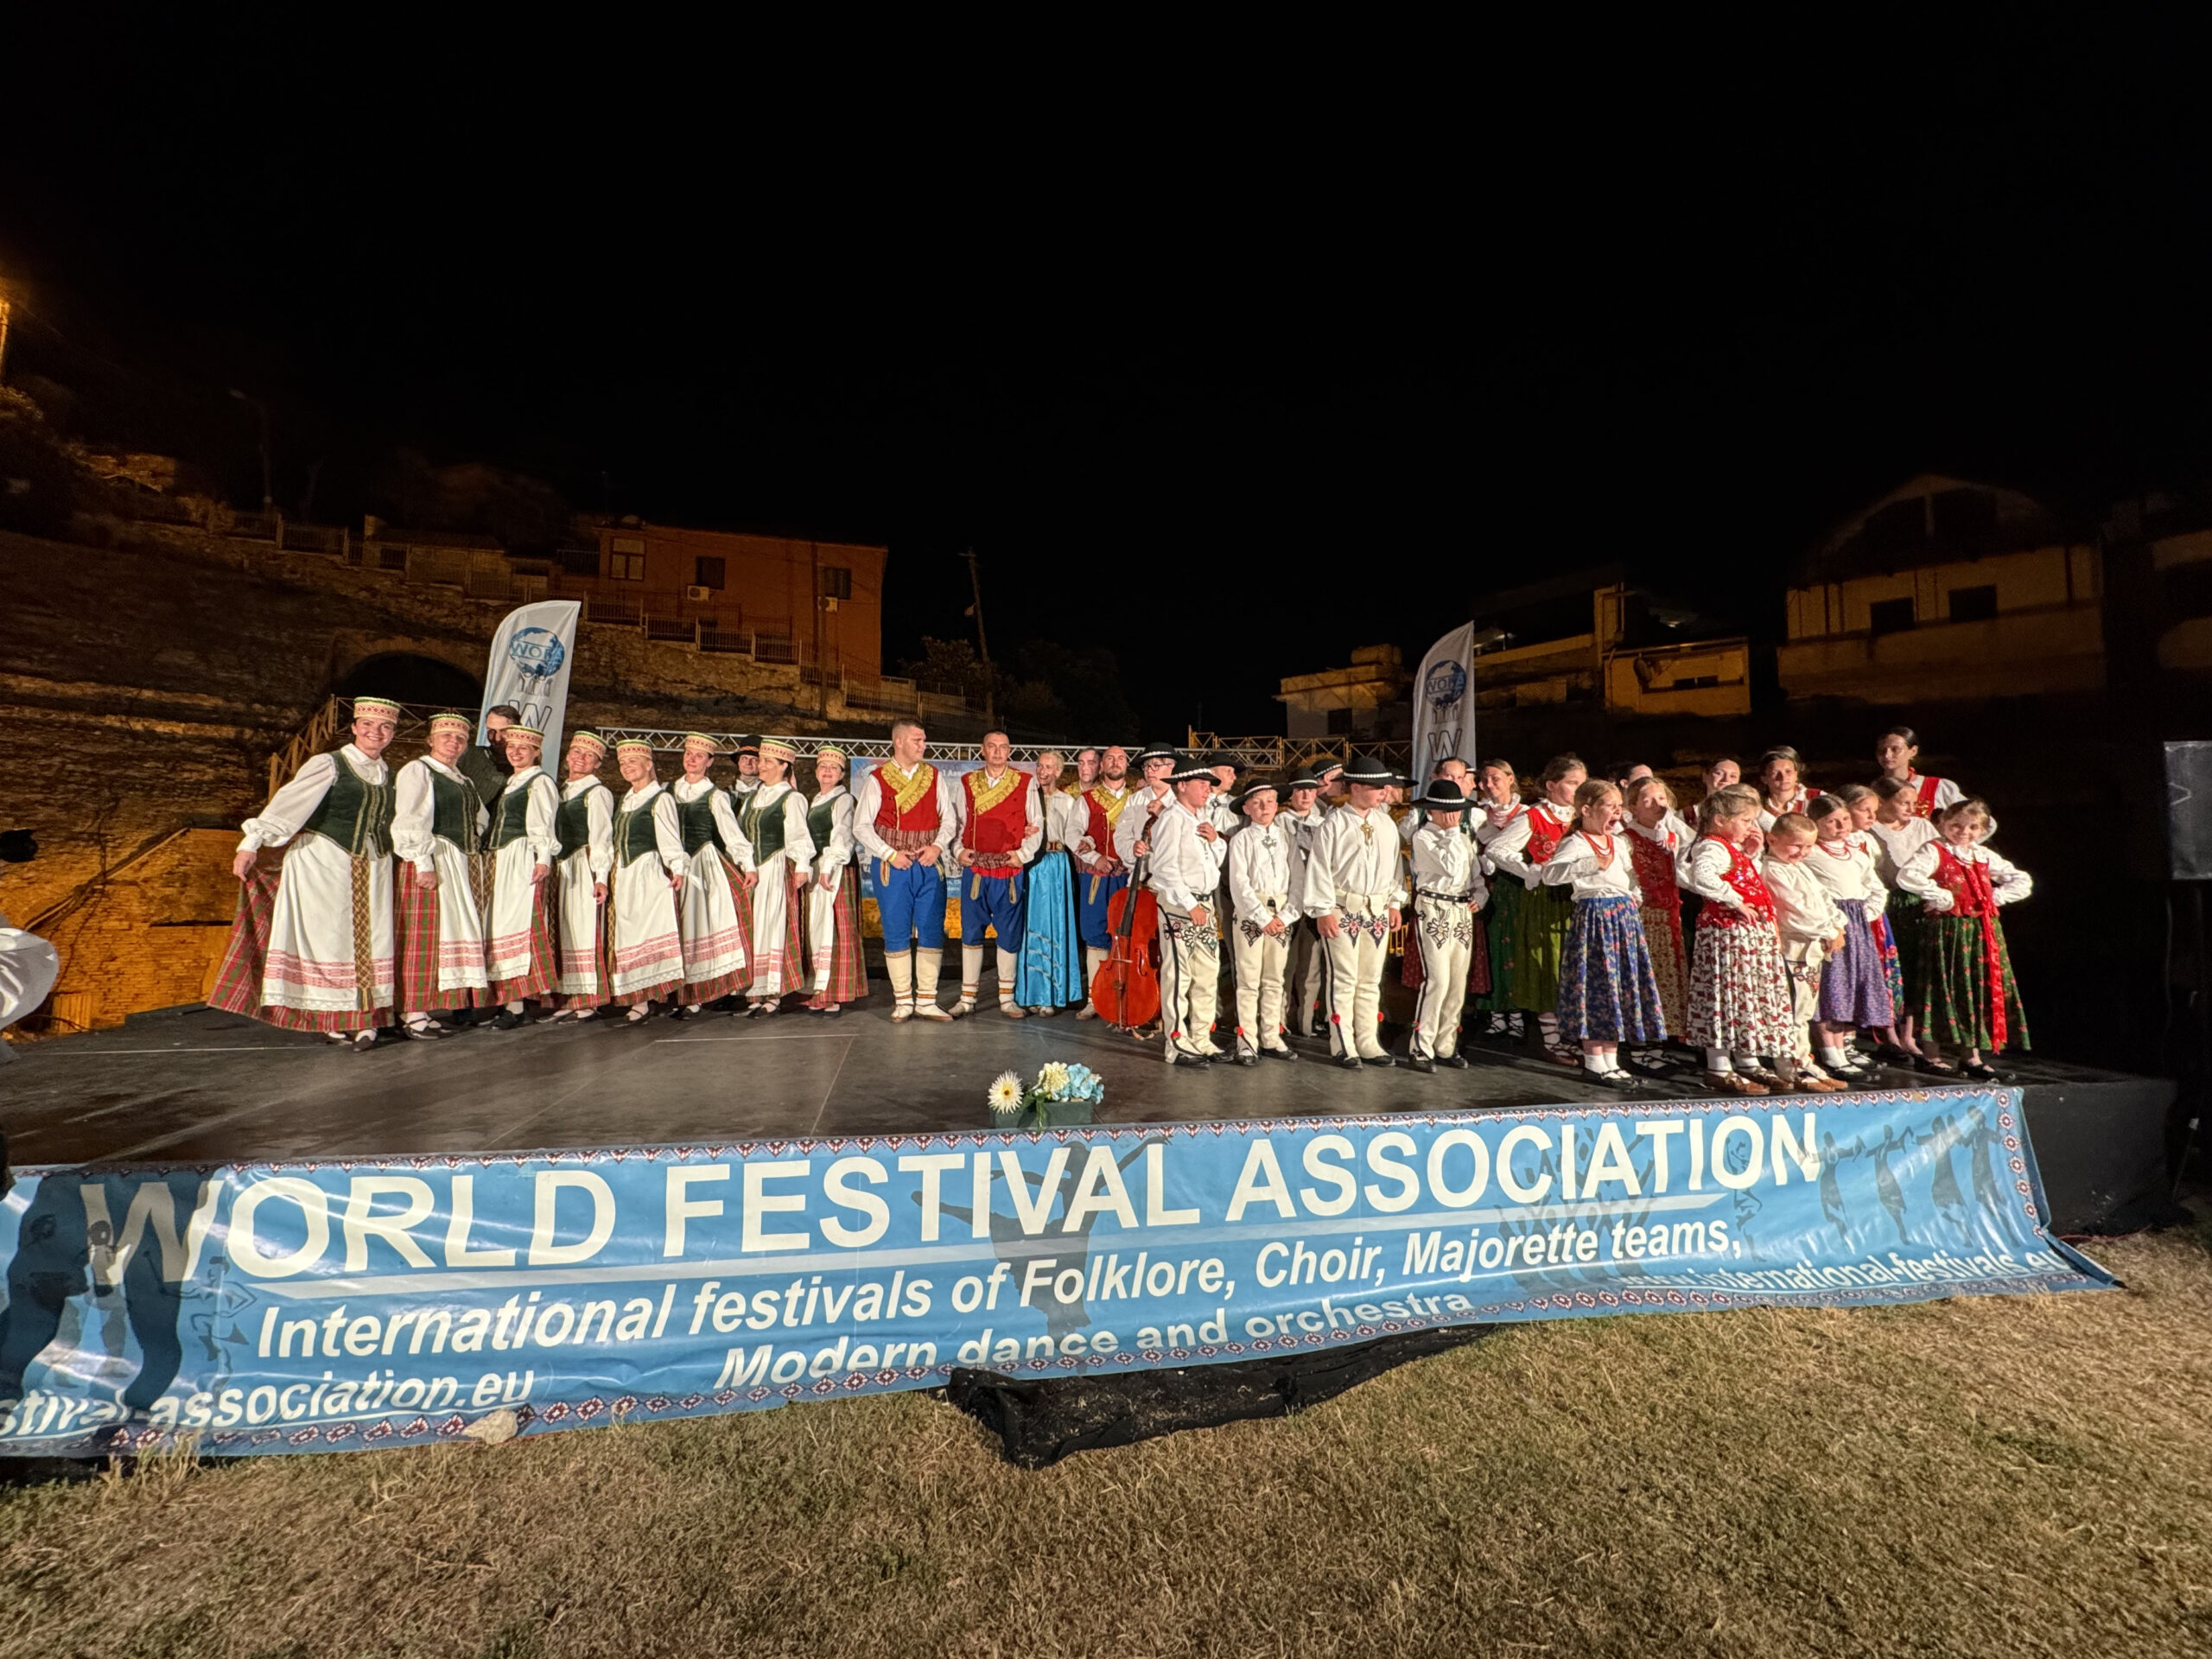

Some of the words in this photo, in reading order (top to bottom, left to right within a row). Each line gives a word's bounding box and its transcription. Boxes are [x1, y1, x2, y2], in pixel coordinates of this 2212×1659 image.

[79, 1170, 616, 1282] WORLD
[662, 1142, 1201, 1257] FESTIVAL
[1224, 1113, 1821, 1223] ASSOCIATION
[258, 1284, 677, 1358] International
[690, 1270, 933, 1335] festivals
[952, 1262, 1010, 1312] of
[1020, 1253, 1235, 1309] Folklore,
[1255, 1236, 1387, 1287] Choir,
[1402, 1224, 1599, 1282] Majorette
[1611, 1218, 1743, 1260] teams,
[713, 1336, 937, 1389] Modern
[957, 1329, 1120, 1368] dance
[1136, 1308, 1228, 1350] and
[1246, 1292, 1474, 1338] orchestra
